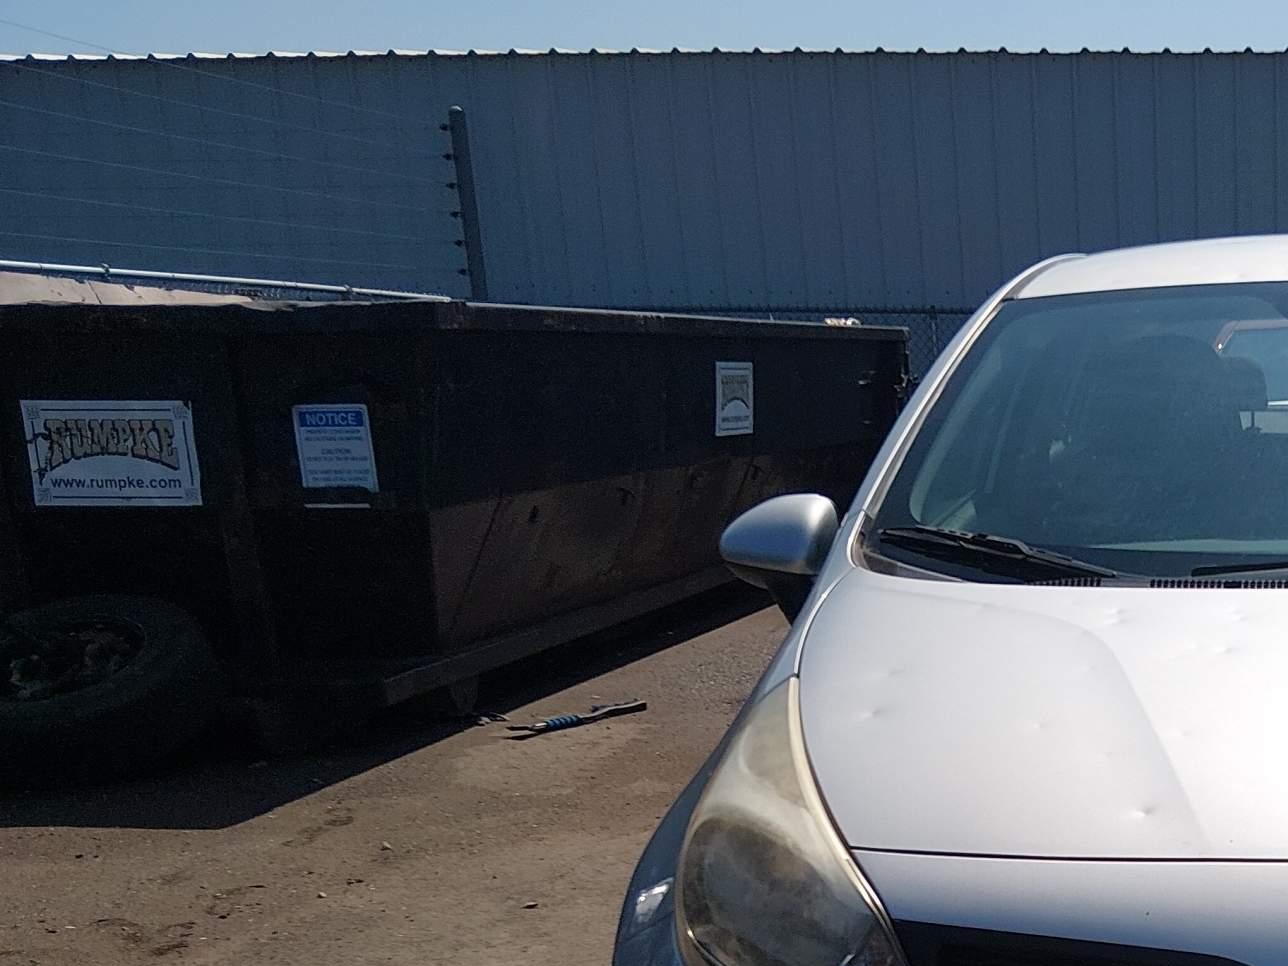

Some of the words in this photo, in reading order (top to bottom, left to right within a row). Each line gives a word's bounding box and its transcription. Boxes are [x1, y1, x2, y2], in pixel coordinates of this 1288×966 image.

[305, 412, 358, 426] NOTICE
[43, 417, 180, 472] RUMPKE
[50, 475, 182, 492] www.rumpke.com
